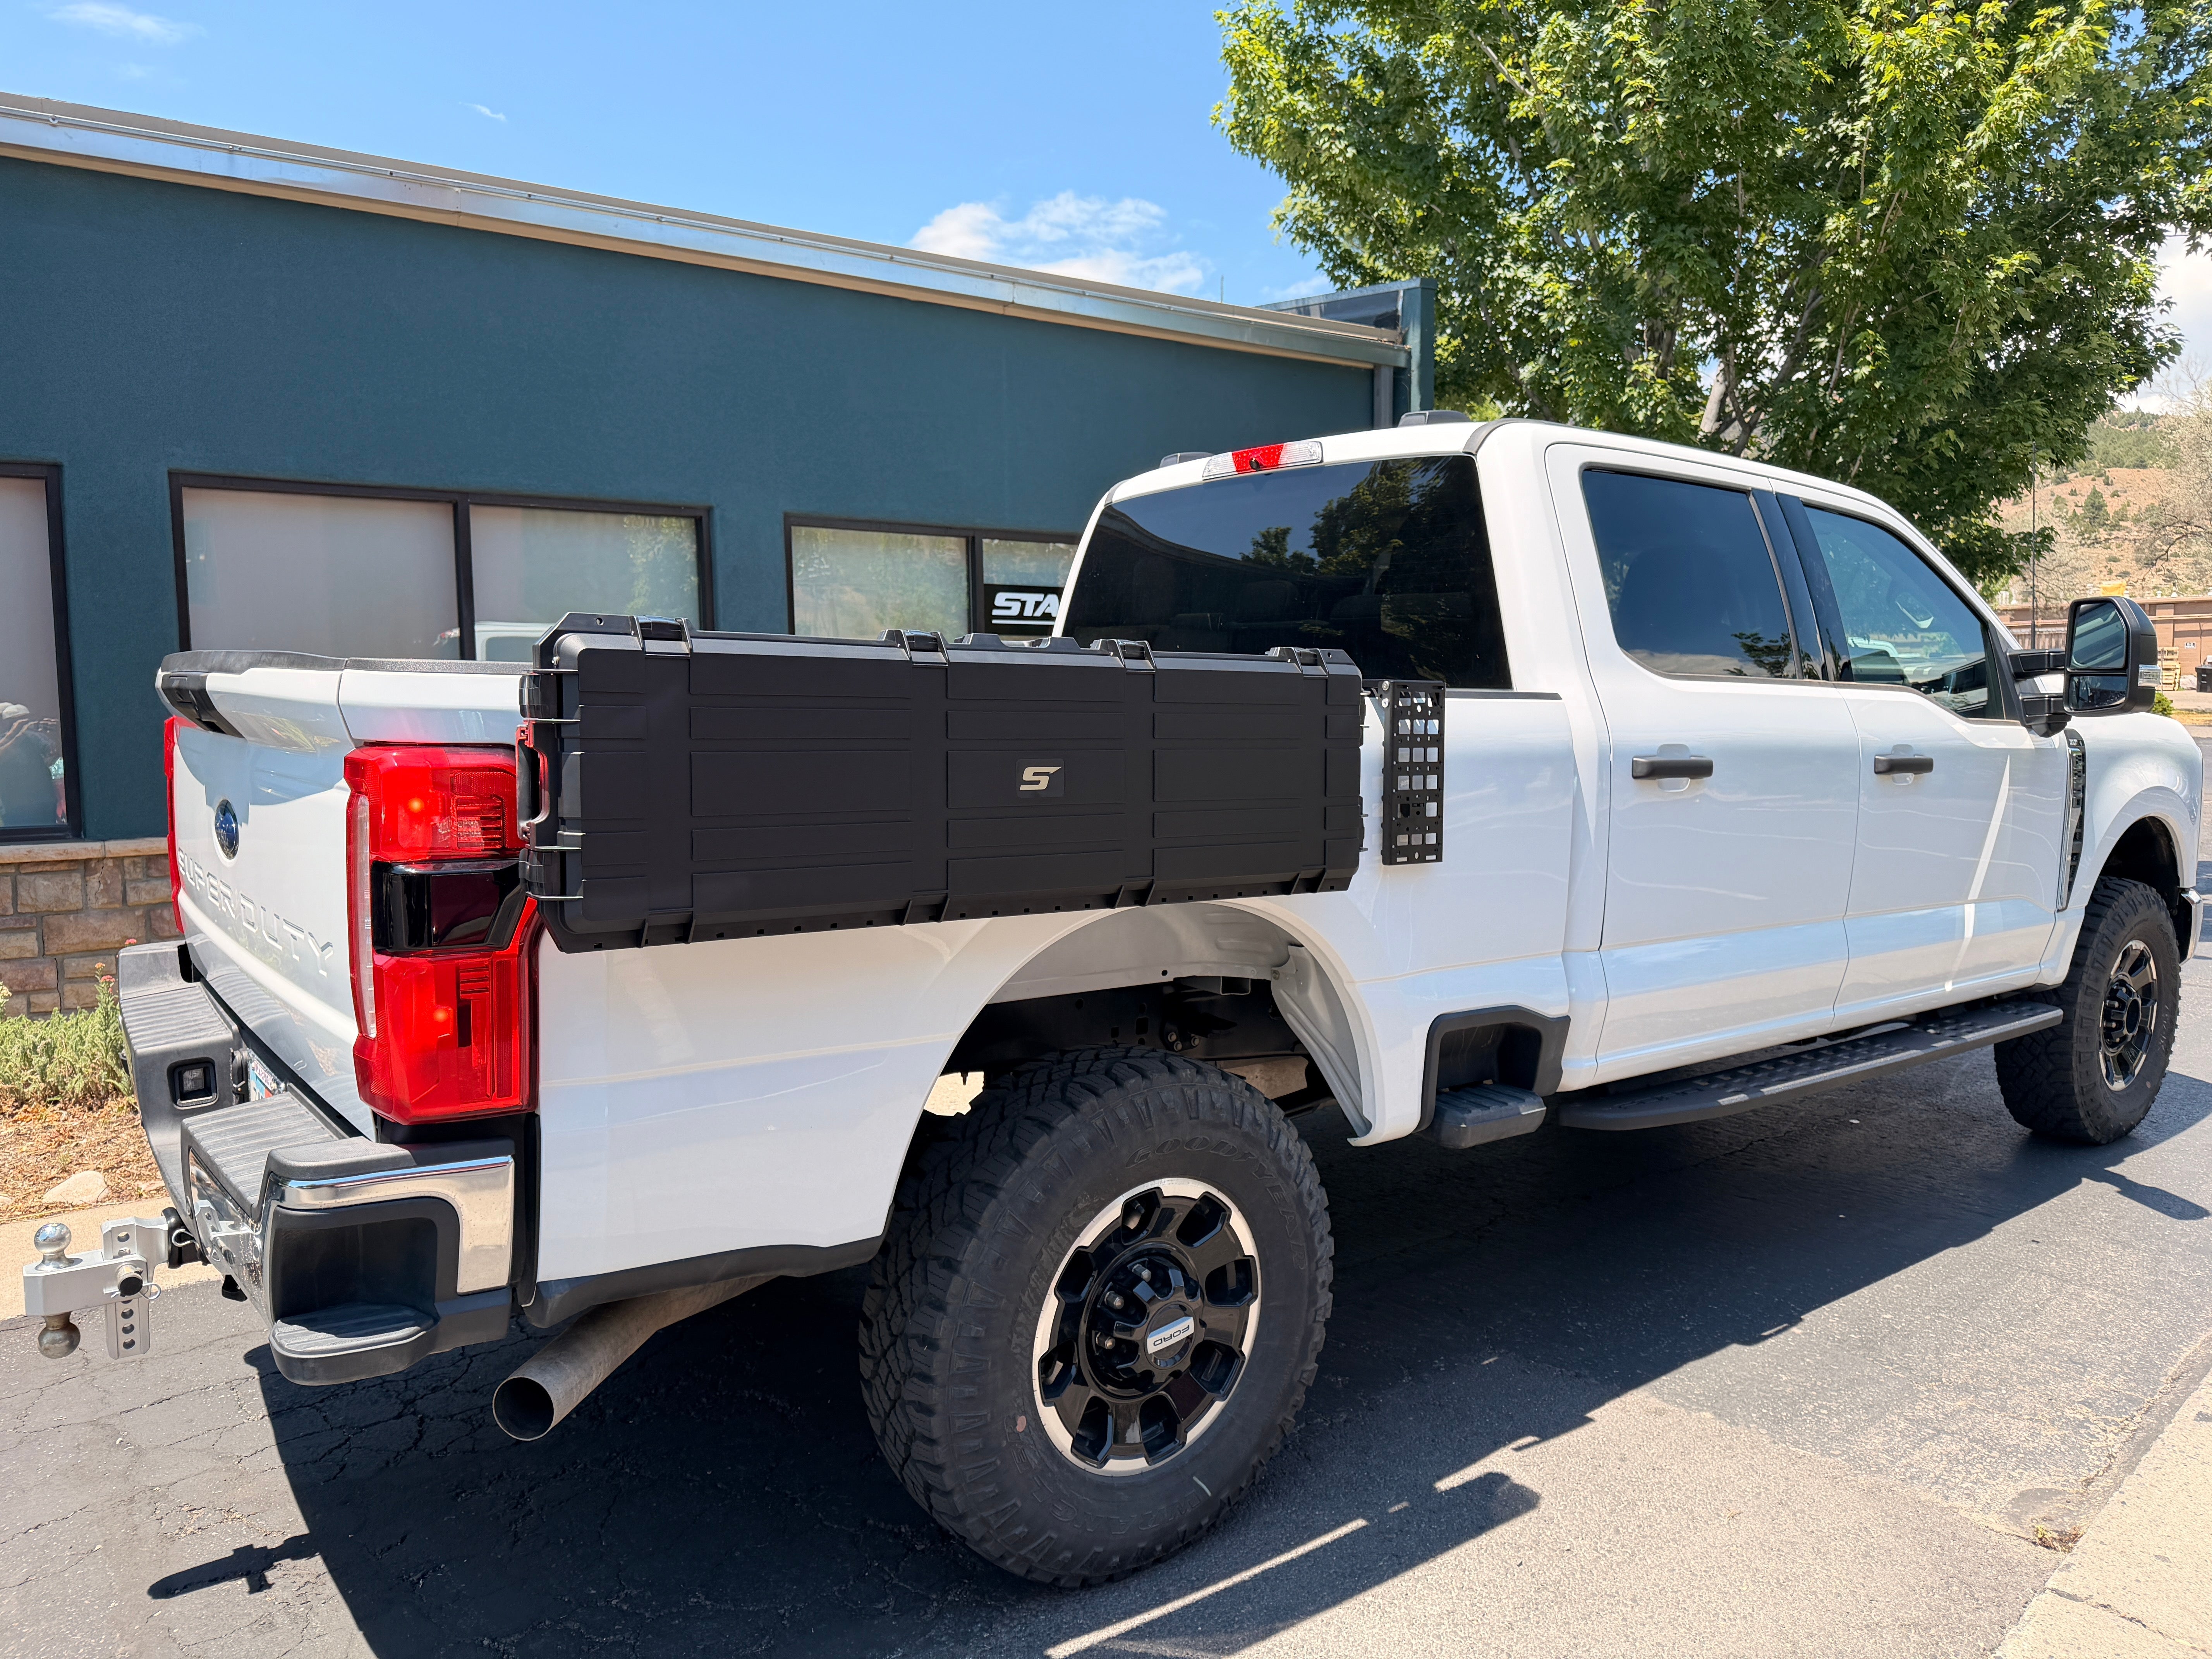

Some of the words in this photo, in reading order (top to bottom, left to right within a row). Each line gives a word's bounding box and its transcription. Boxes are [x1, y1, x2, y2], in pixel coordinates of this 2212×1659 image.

[178, 847, 235, 919] SUPER
[240, 892, 333, 977] DUTY
[1125, 1135, 1309, 1270] GOODYEAR
[1153, 1325, 1189, 1346] FORD
[1004, 1414, 1202, 1534] WRANGLER
